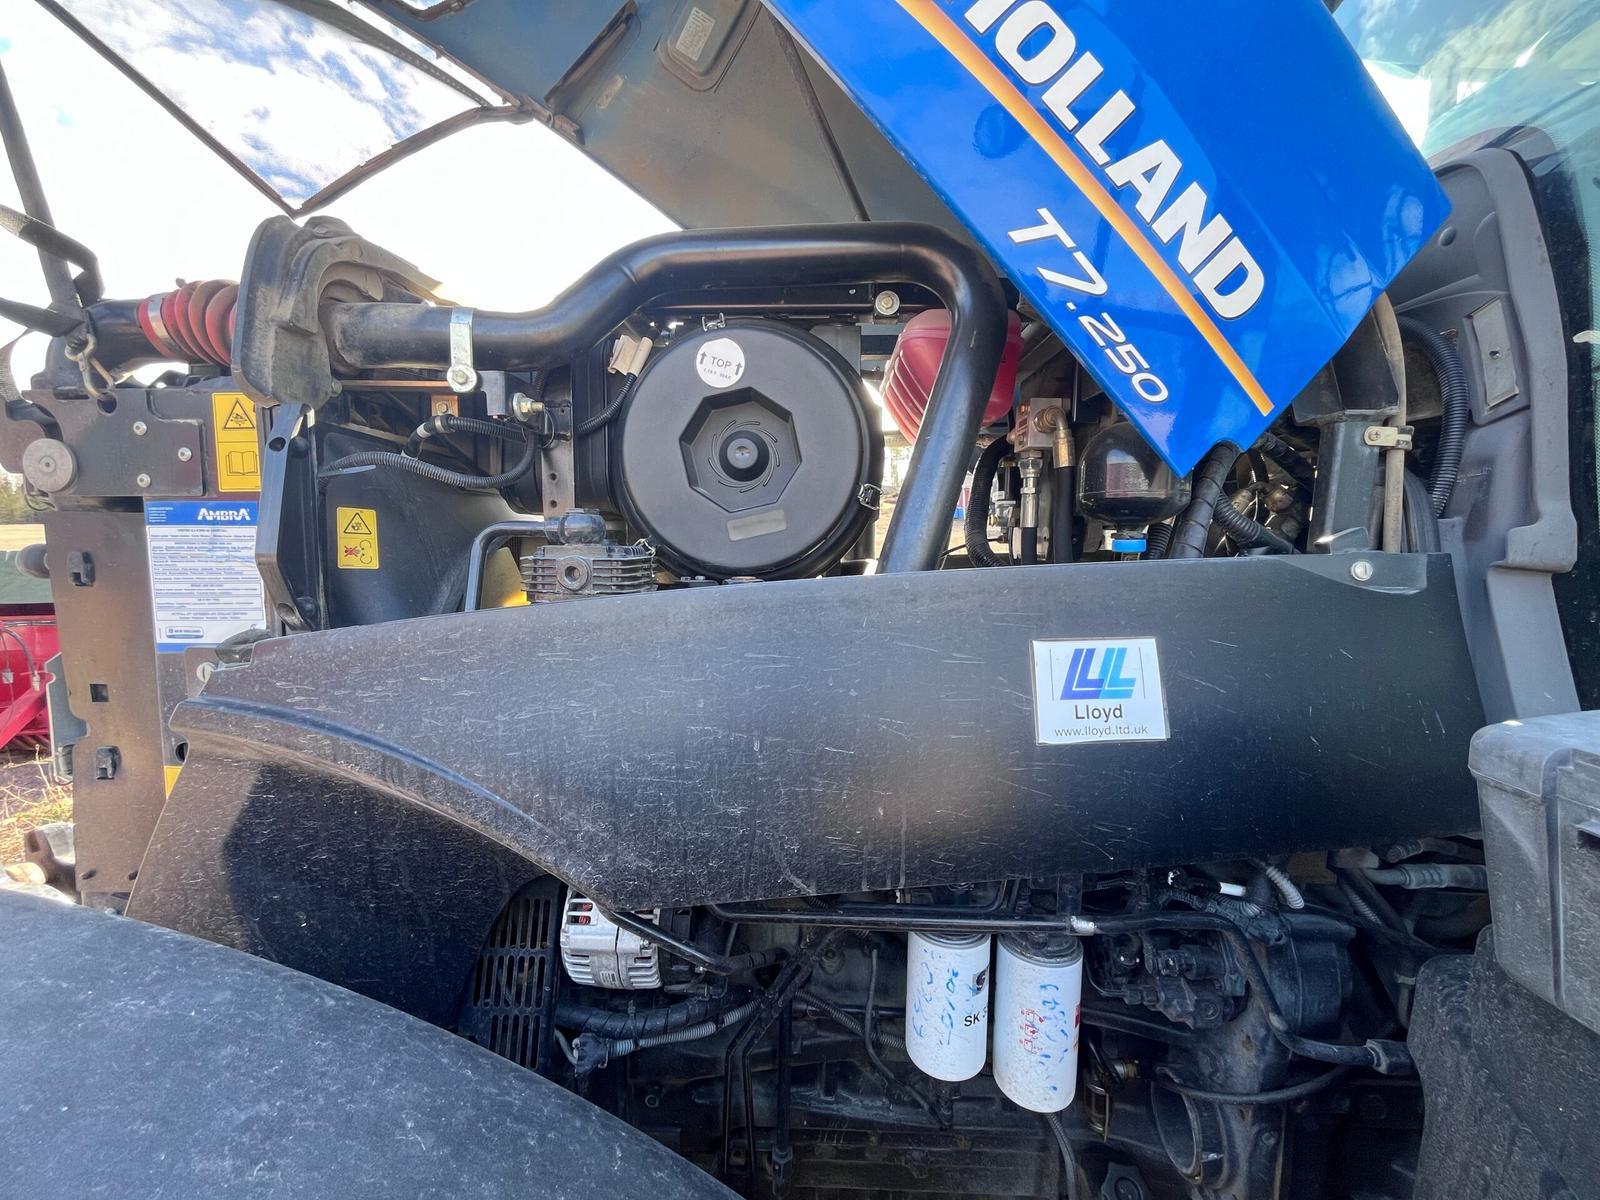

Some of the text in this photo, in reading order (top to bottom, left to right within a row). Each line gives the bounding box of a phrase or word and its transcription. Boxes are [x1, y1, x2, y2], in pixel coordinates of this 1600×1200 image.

[1008, 207, 1169, 402] T7.250
[711, 356, 732, 368] TOP
[197, 508, 251, 521] AMBRA
[1074, 703, 1123, 723] Lloyd
[1054, 724, 1149, 737] www.lloyd.ltd.uk
[964, 1011, 981, 1027] SK
